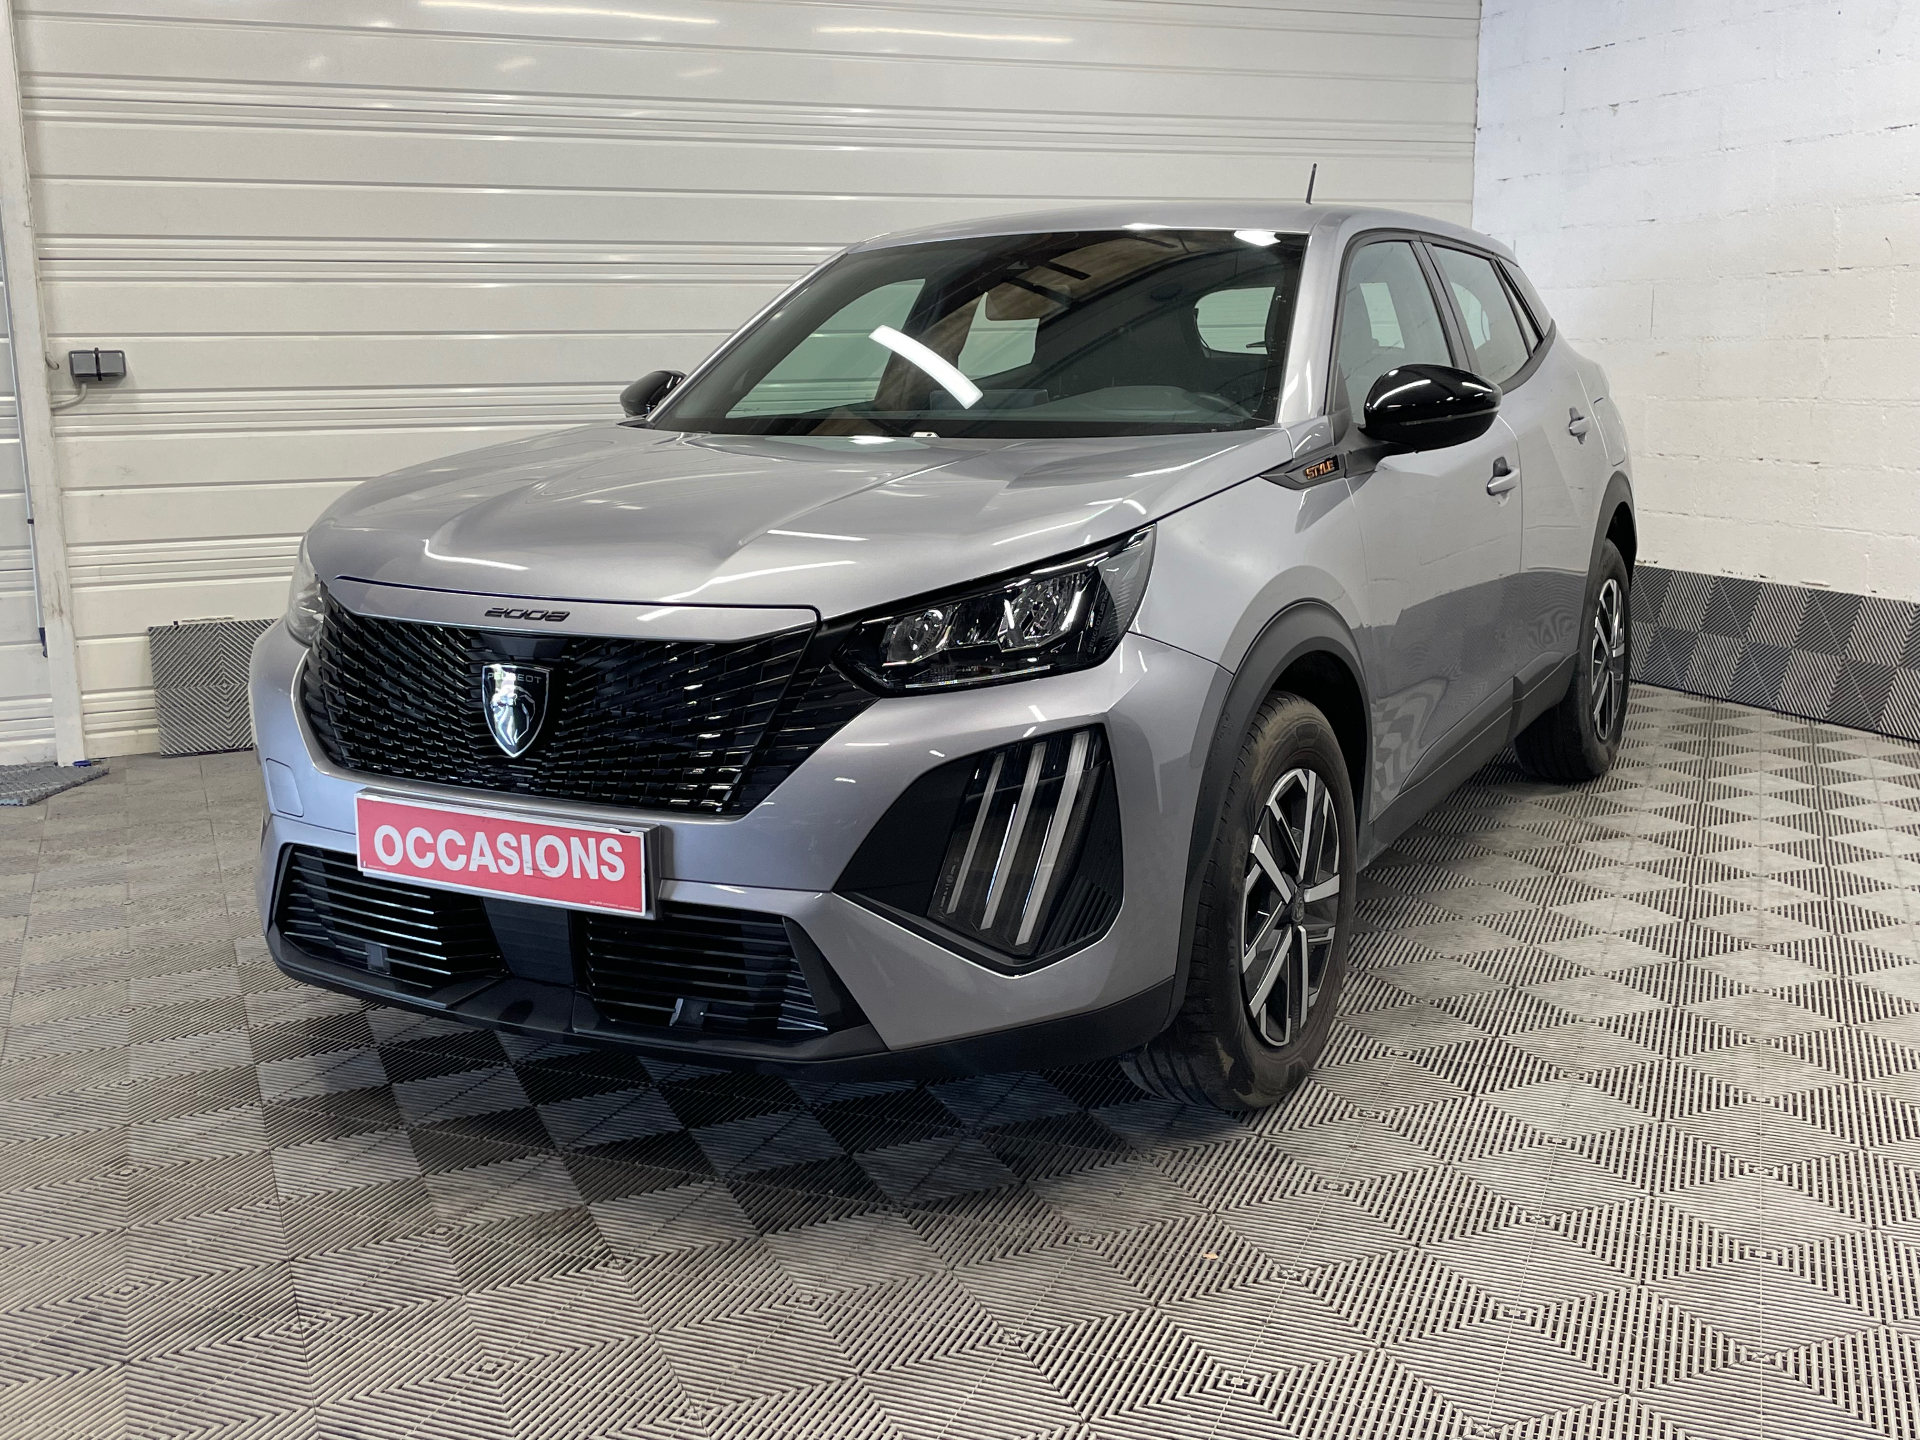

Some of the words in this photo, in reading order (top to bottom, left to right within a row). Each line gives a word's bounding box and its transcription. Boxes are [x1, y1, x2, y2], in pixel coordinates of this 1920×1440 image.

[1306, 460, 1335, 479] STYLE
[485, 607, 571, 622] 2008
[373, 824, 626, 882] OCCASIONS
